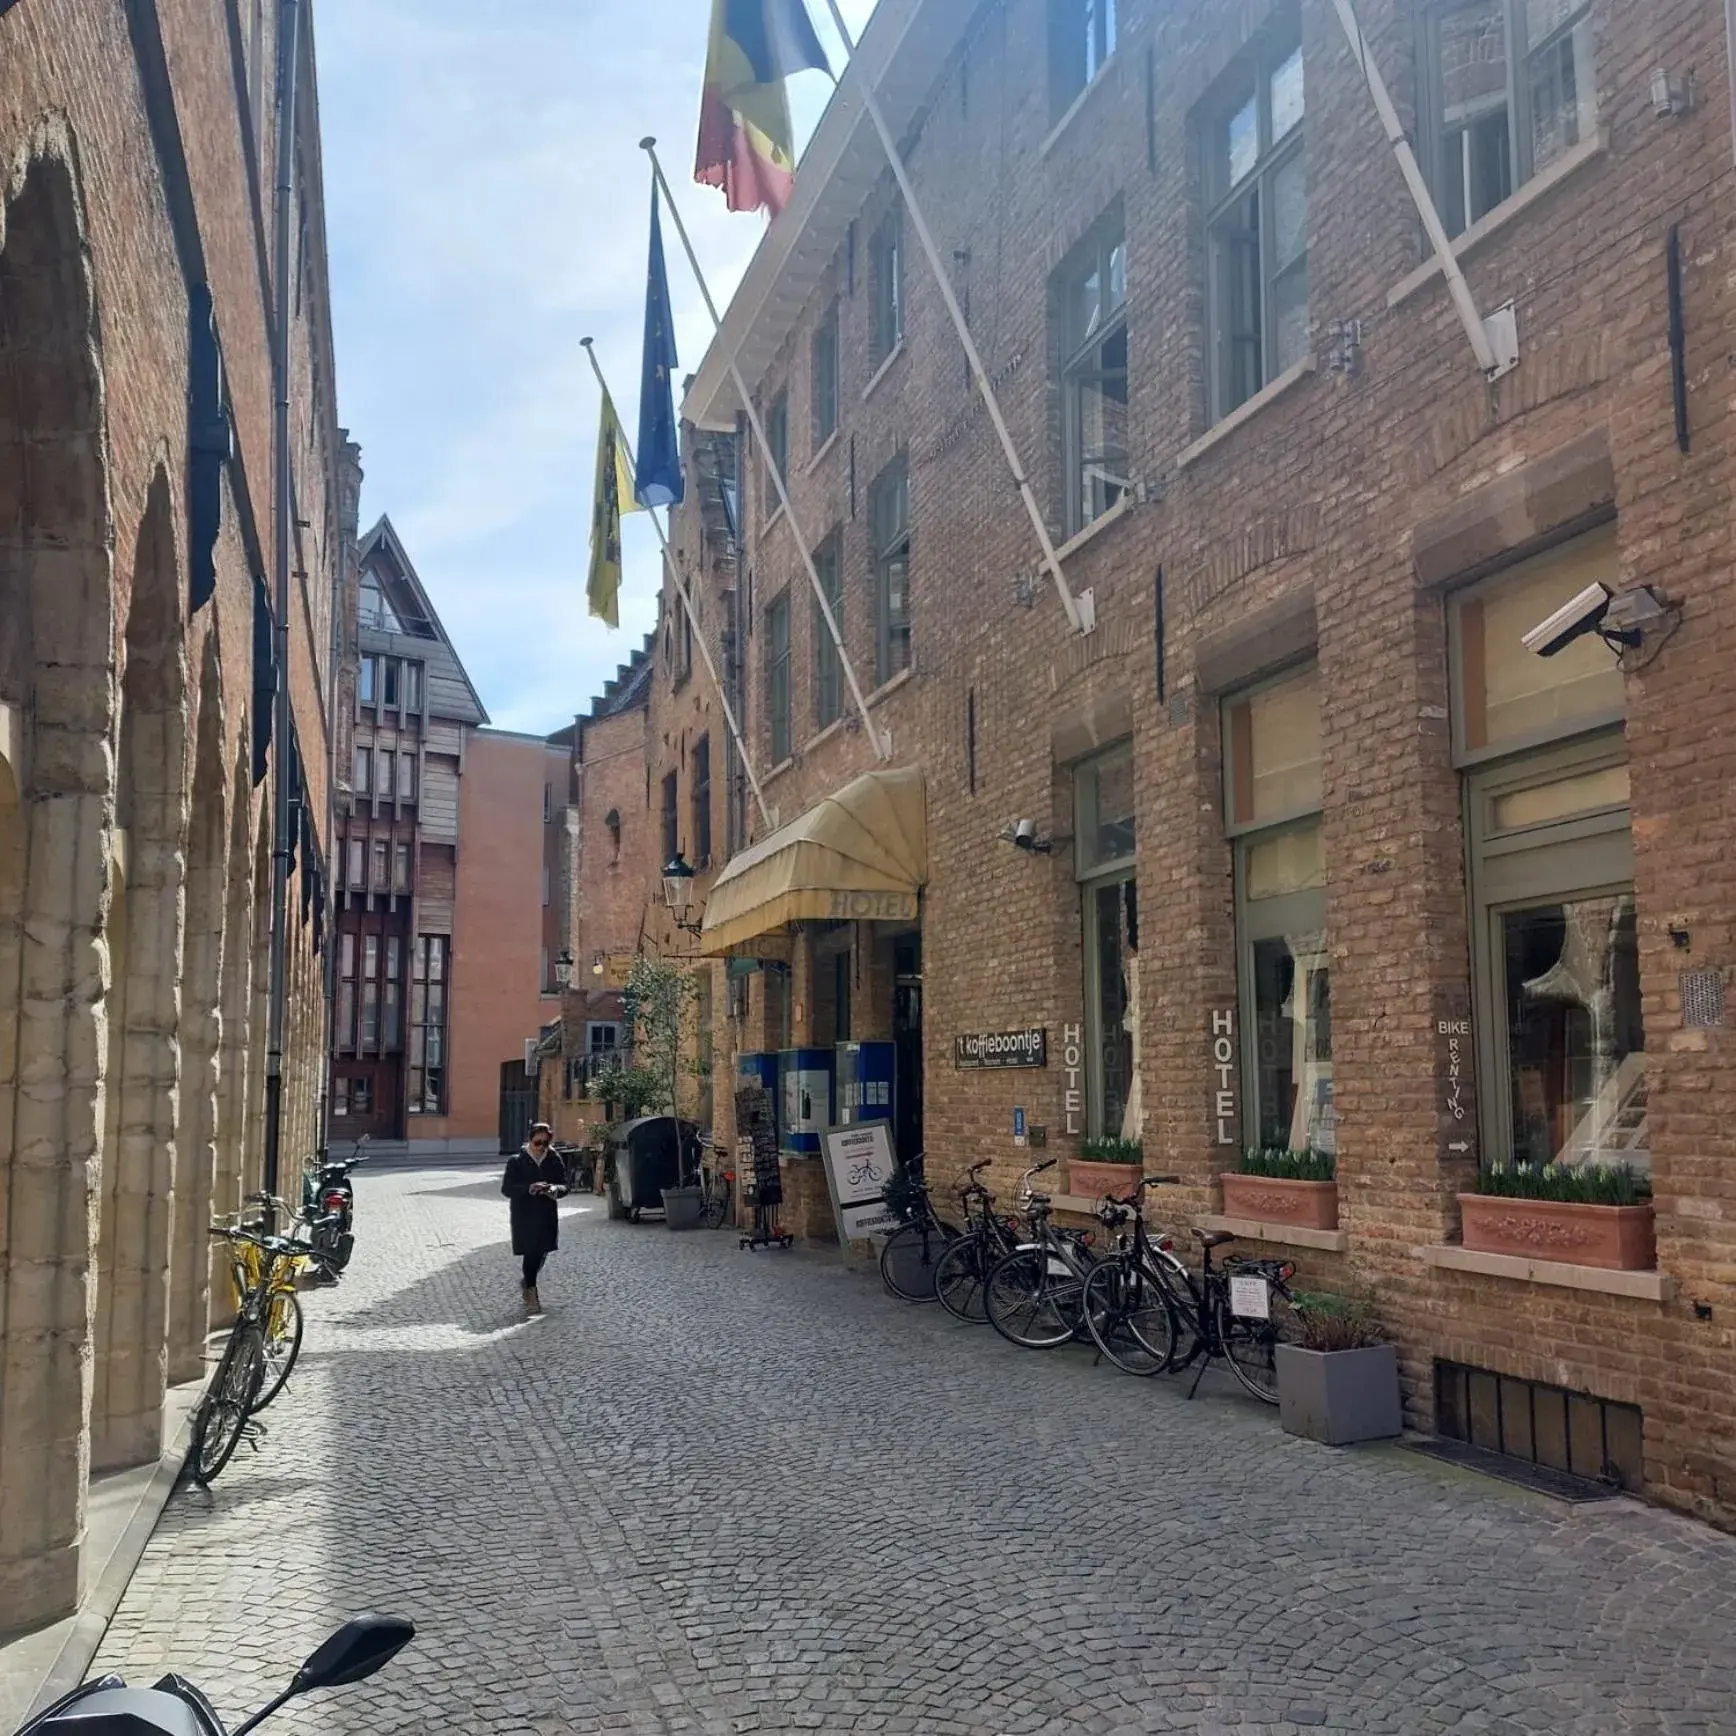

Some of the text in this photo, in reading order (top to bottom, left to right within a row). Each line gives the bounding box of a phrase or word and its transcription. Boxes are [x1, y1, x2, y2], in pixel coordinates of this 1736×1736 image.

[965, 1028, 1041, 1059] koffieboontje
[1438, 1021, 1469, 1034] BIKE
[1063, 1023, 1080, 1134] HOTEL
[1212, 1009, 1234, 1144] HOTEL
[1447, 1038, 1465, 1120] RENTING
